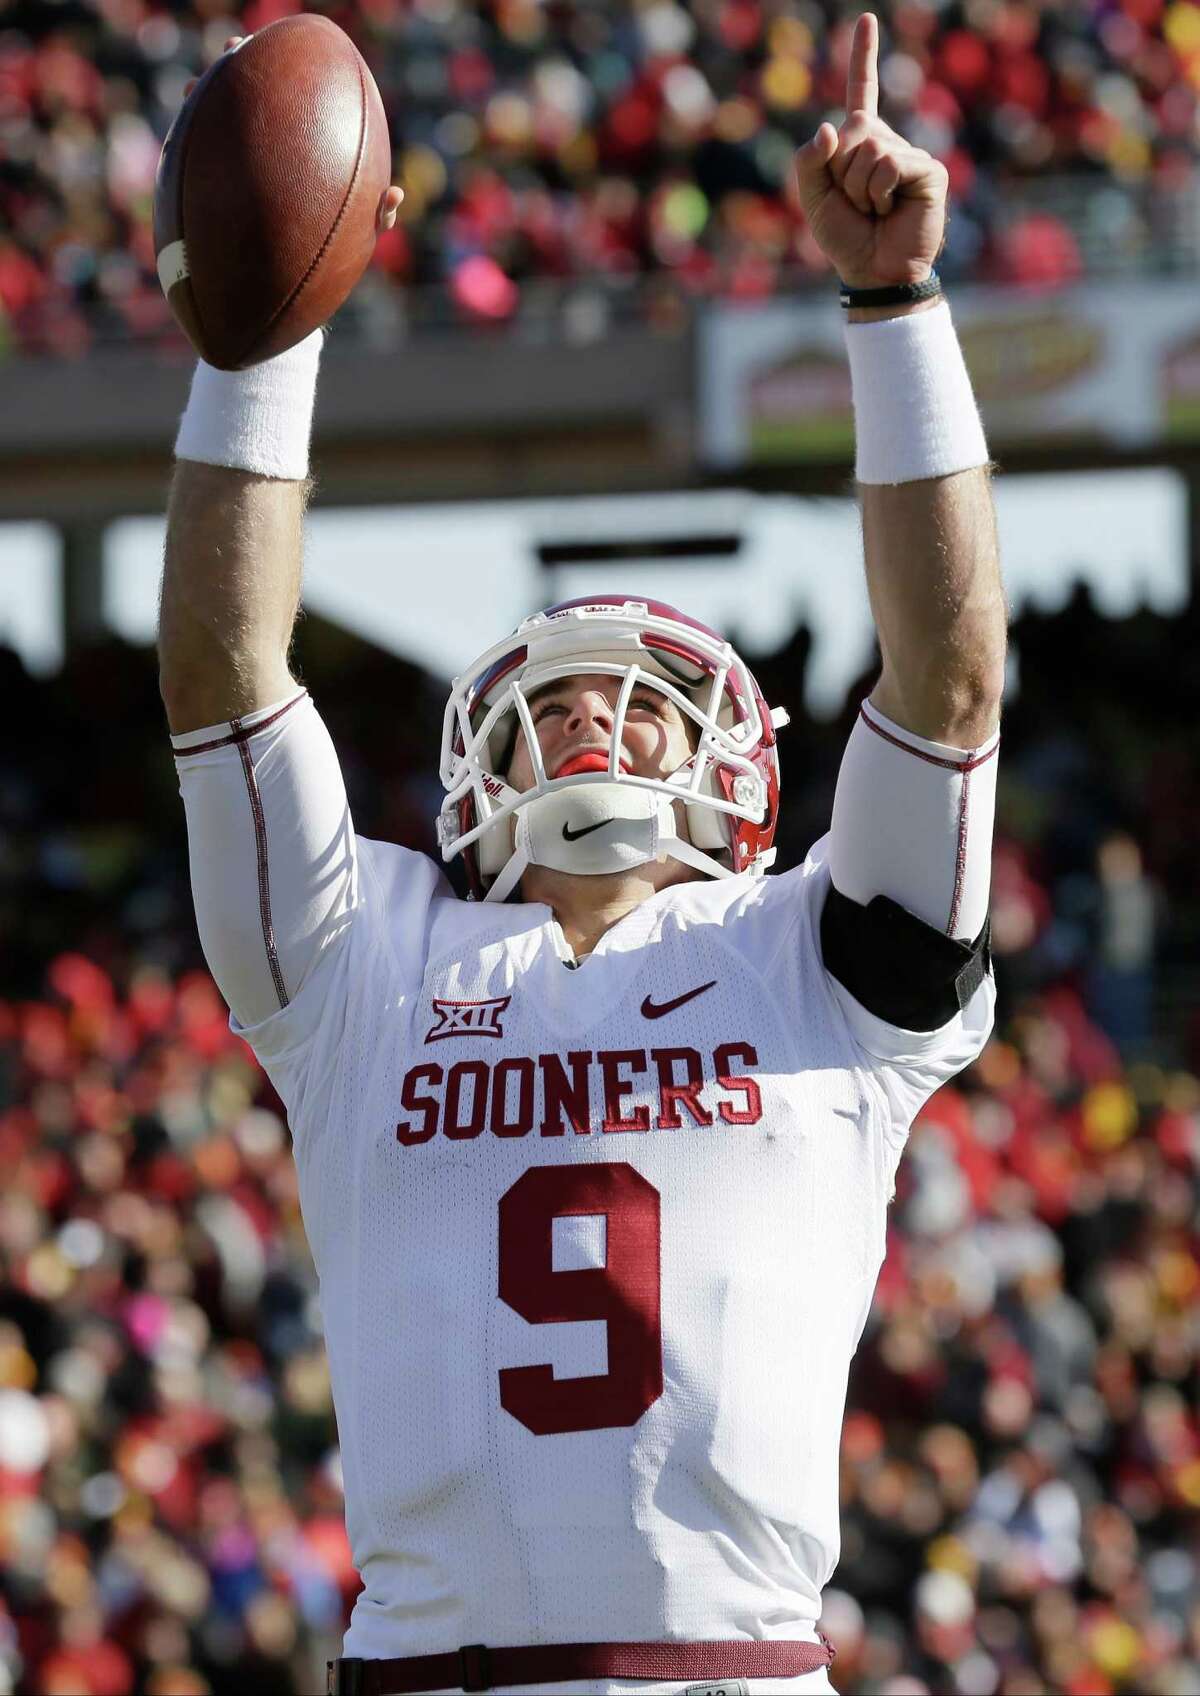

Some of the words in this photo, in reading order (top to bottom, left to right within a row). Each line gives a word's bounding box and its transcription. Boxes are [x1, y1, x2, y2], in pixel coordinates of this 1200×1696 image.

[424, 995, 512, 1045] XII
[396, 1041, 763, 1147] SOONERS
[498, 1162, 664, 1436] 9
